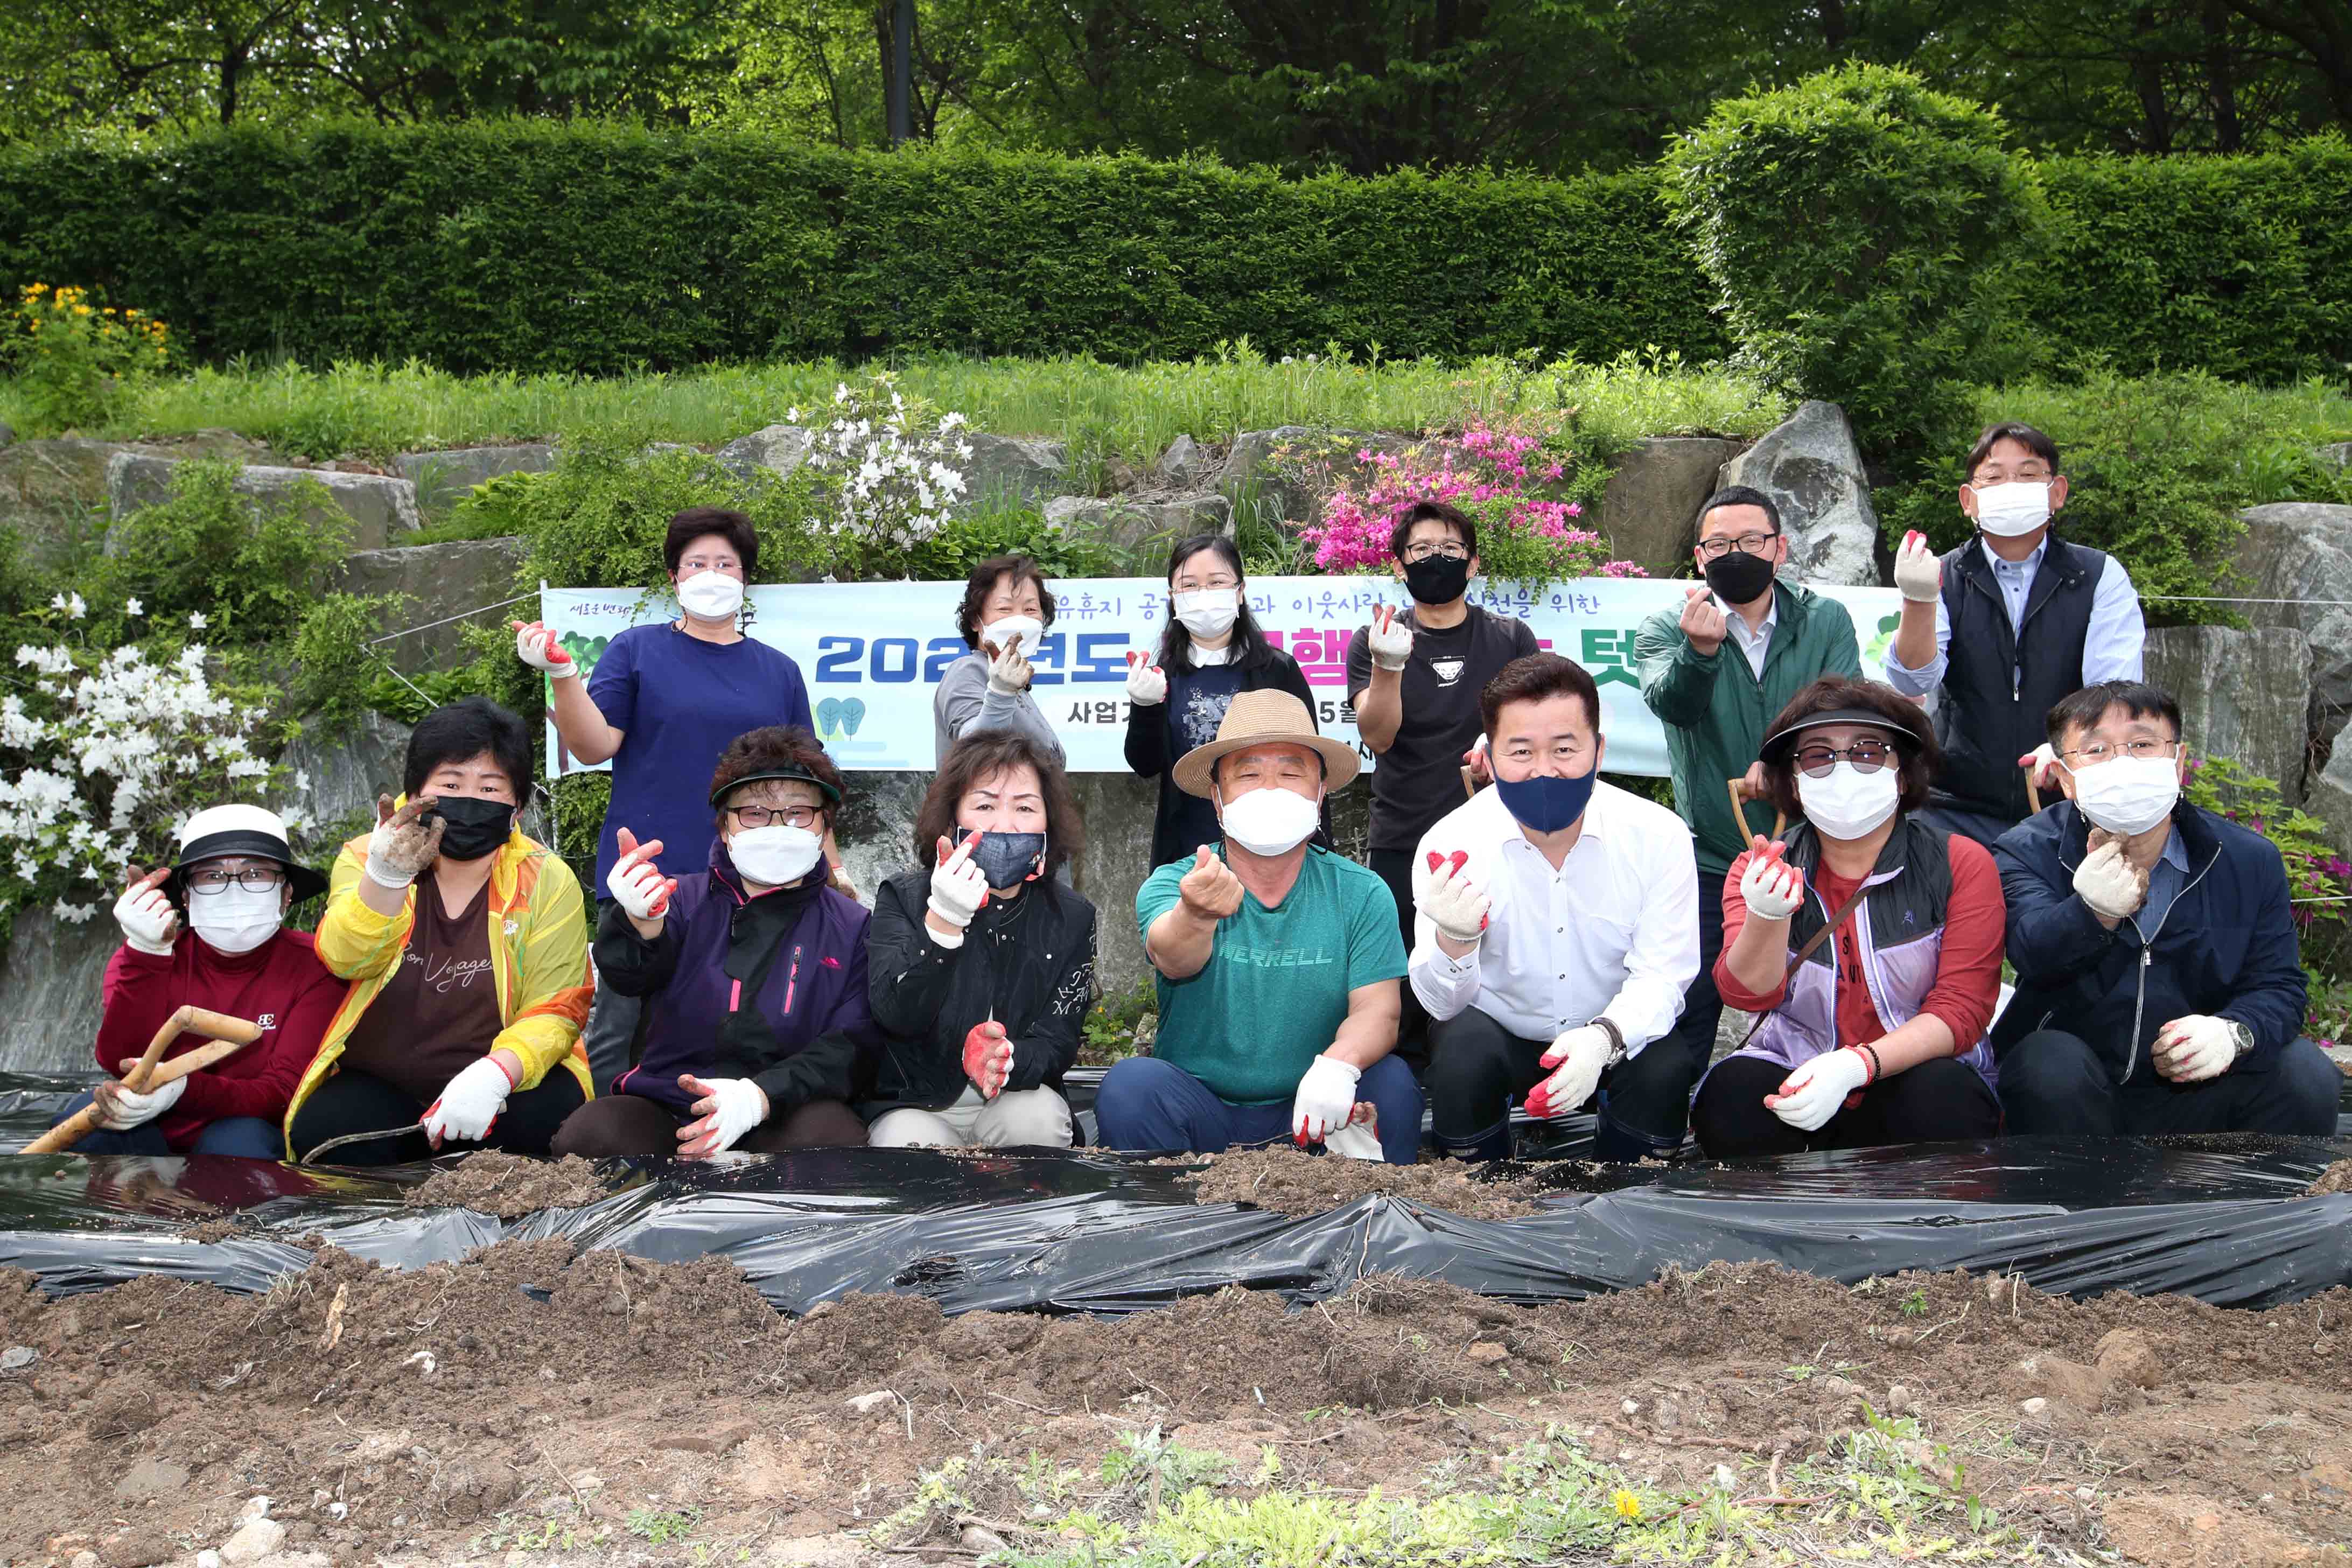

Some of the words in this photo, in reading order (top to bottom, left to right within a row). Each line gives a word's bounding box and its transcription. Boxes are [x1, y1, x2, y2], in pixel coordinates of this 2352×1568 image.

[570, 603, 599, 615] 새로운
[1054, 592, 1121, 620] 유휴지
[1550, 593, 1601, 614] 위한
[815, 633, 1130, 684] 202년도
[1067, 701, 1131, 723] 사업
